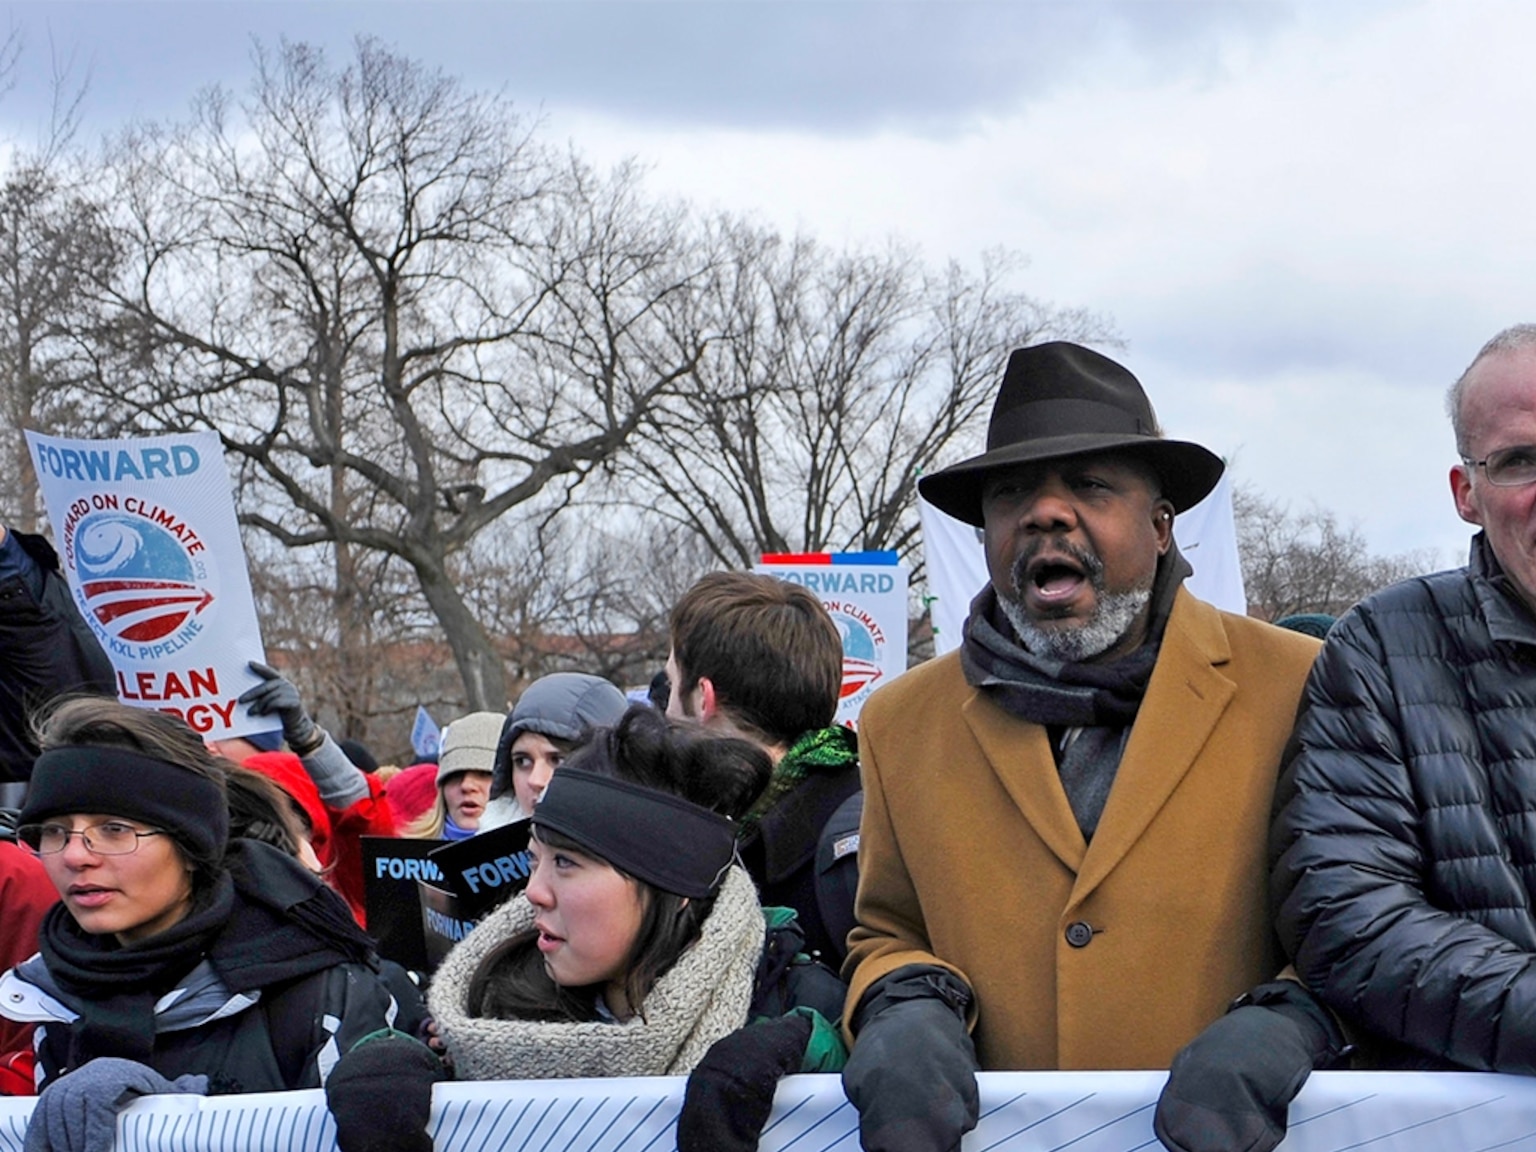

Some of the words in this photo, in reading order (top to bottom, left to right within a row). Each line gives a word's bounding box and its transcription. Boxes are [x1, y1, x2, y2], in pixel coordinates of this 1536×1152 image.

[37, 443, 200, 481] FORWARD
[64, 498, 90, 570] FORWARD
[92, 494, 118, 510] ON
[125, 497, 206, 556] CLIMATE
[110, 638, 136, 659] KXL
[140, 619, 204, 659] PIPELINE
[843, 603, 885, 646] CLIMATE
[117, 667, 218, 700] LEAN
[375, 857, 445, 881] FORW
